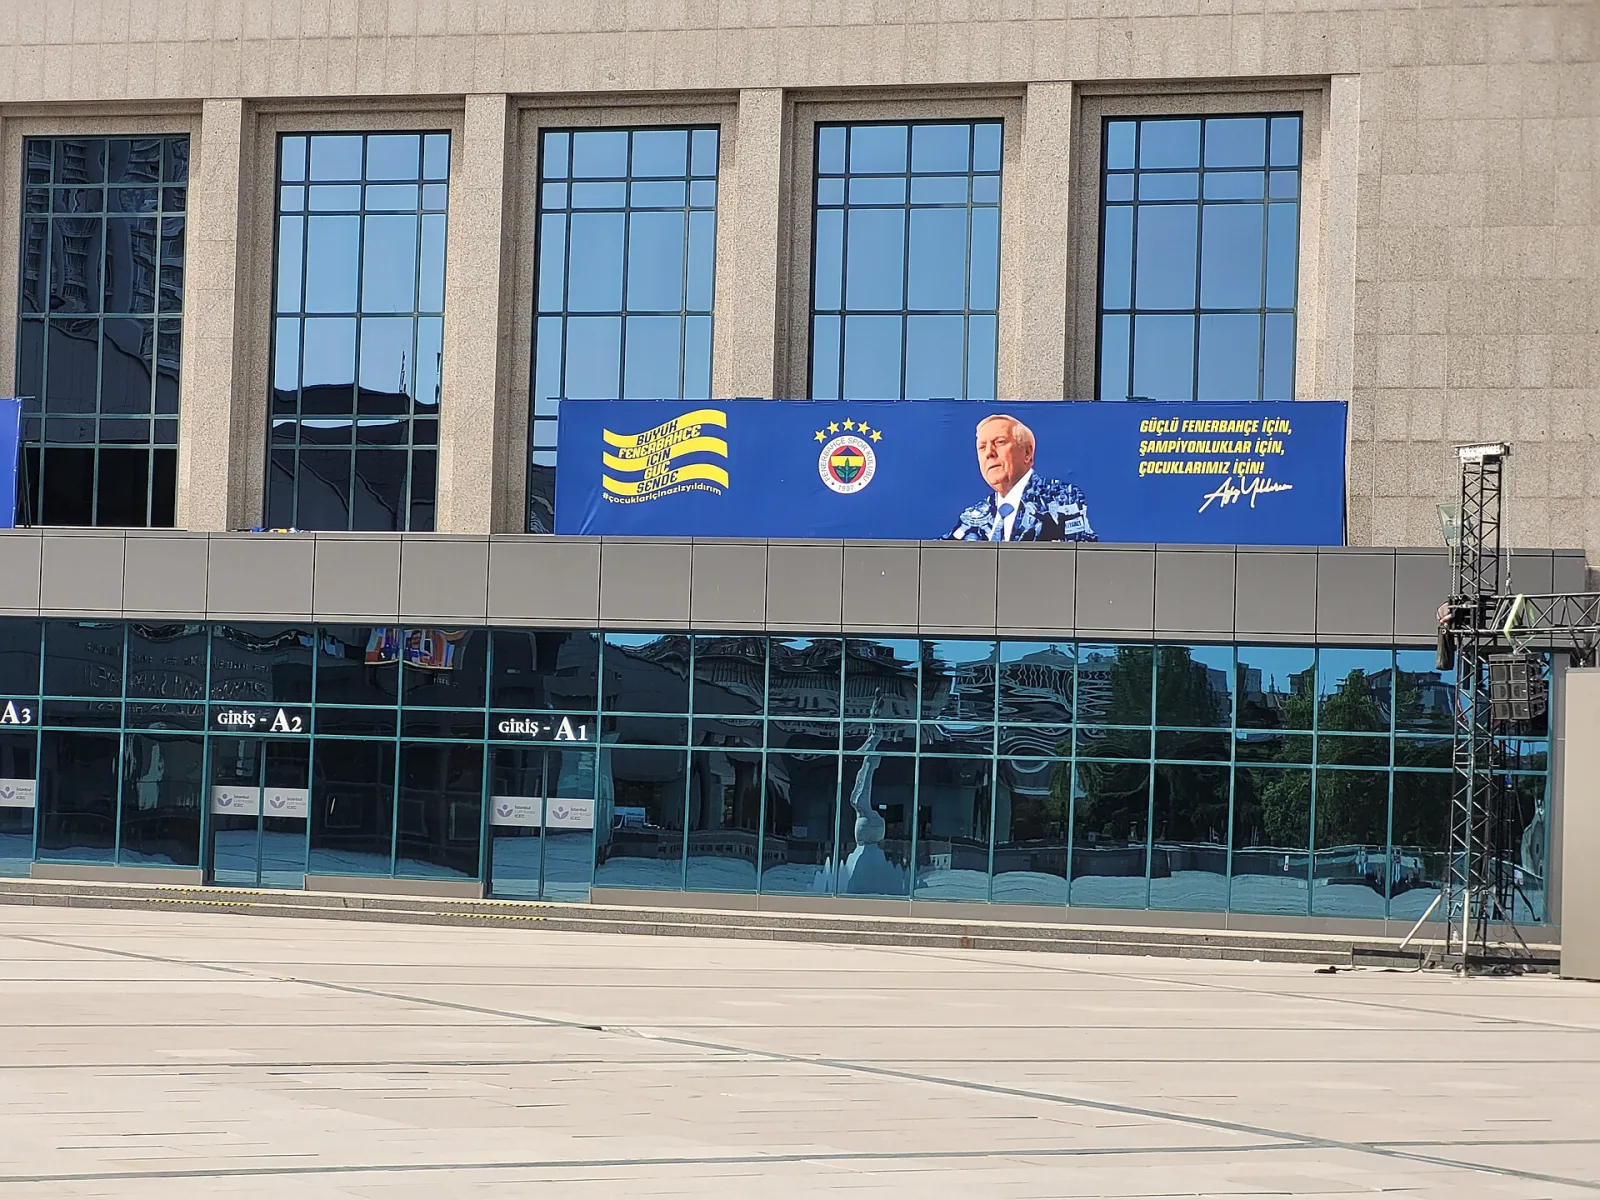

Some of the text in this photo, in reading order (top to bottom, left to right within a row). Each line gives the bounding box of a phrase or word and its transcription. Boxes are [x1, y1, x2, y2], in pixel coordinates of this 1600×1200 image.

[1140, 416, 1293, 436] GÜÇLÜ FENERBAHÇE İÇİN,
[847, 437, 868, 452] SPOR
[1139, 437, 1285, 456] ŞAMPİYONLUKLAR İÇİN,
[1138, 458, 1265, 477] ÇOCUKLARIMIZ İÇİN!
[636, 470, 679, 494] SENDE
[0, 700, 31, 724] A3
[217, 710, 255, 728] GİRİŞ
[269, 707, 303, 733] A2
[498, 718, 539, 737] GİRİŞ
[554, 716, 588, 740] A1
